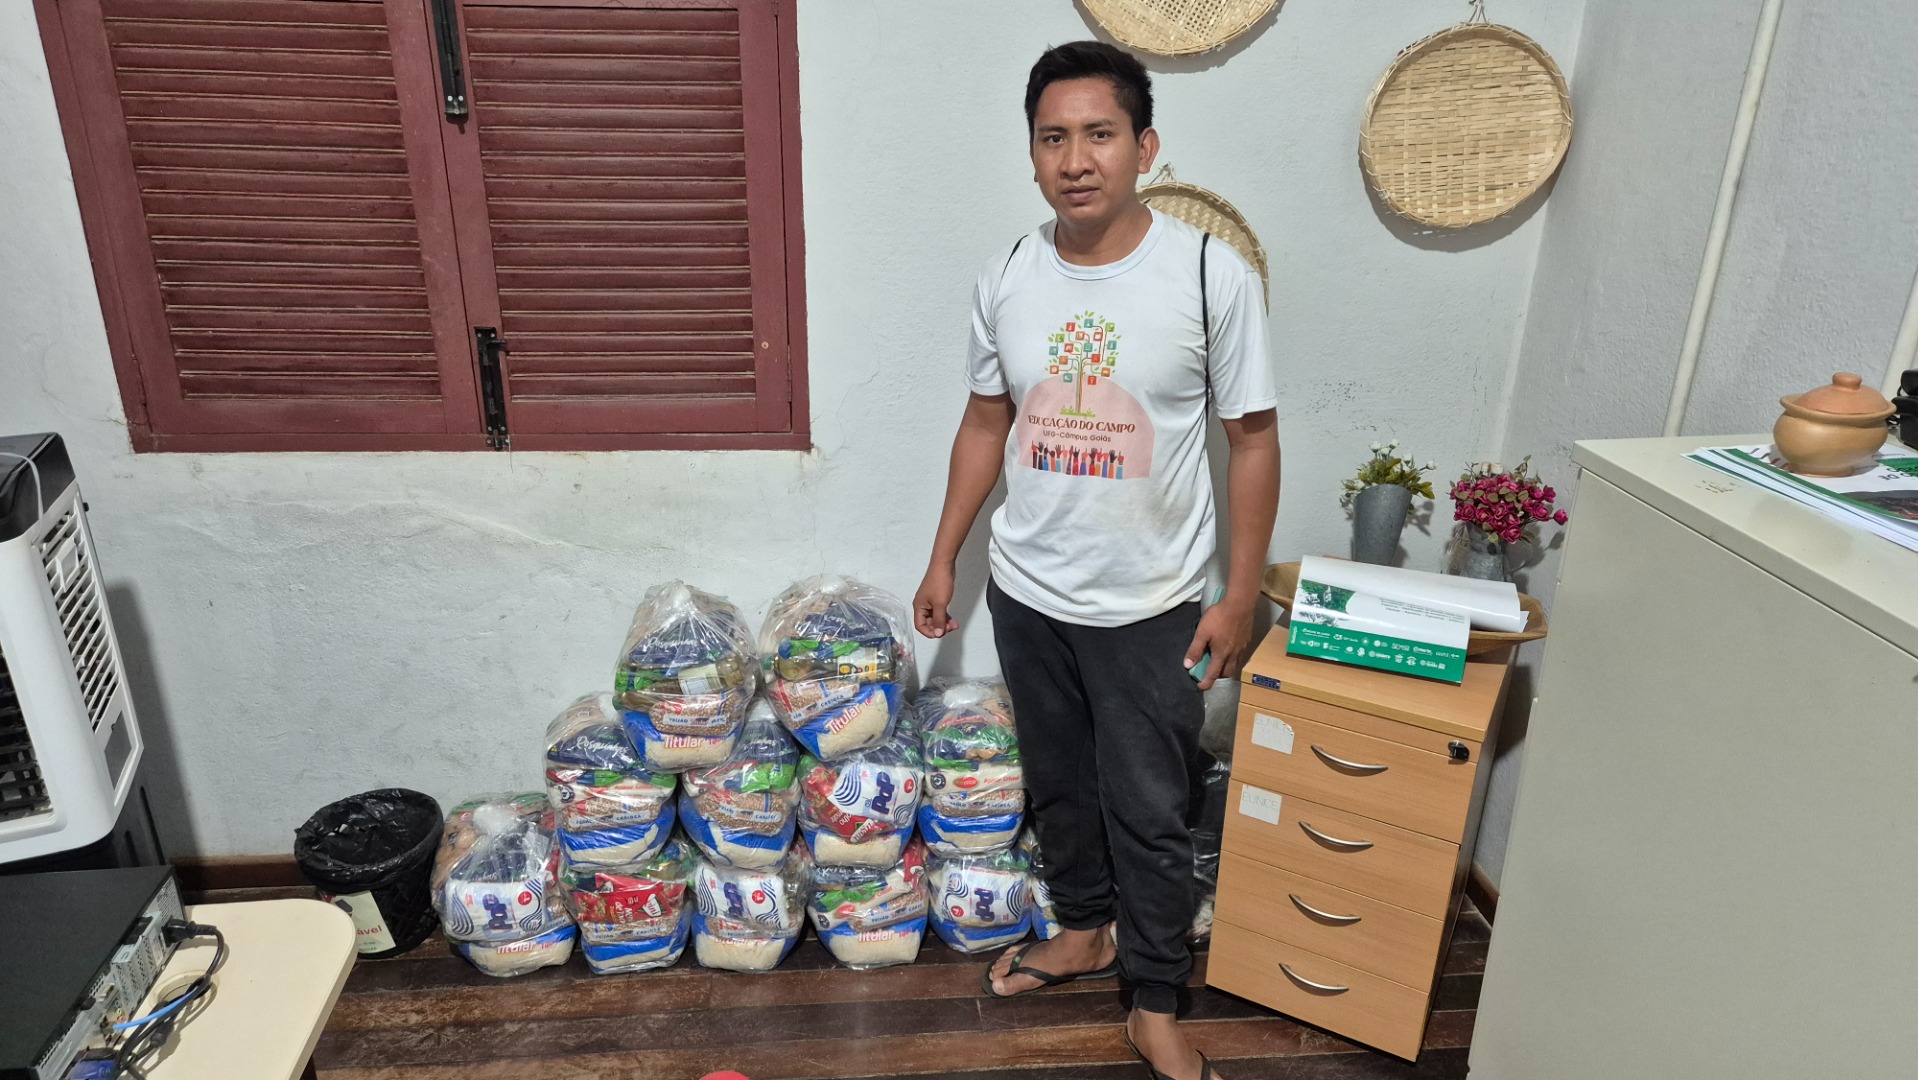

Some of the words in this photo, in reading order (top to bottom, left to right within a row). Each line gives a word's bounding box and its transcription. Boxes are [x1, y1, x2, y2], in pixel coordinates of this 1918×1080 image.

[1028, 415, 1077, 430] EDUCAÇÃO
[1079, 420, 1094, 431] DO
[1095, 421, 1136, 434] CAMPO
[1043, 430, 1088, 441] UFG-Câmpus
[1089, 434, 1112, 443] Goiás
[825, 702, 862, 736] Titular
[576, 735, 629, 758] Rosquinhas
[663, 734, 704, 750] Titular
[858, 929, 895, 943] Titular
